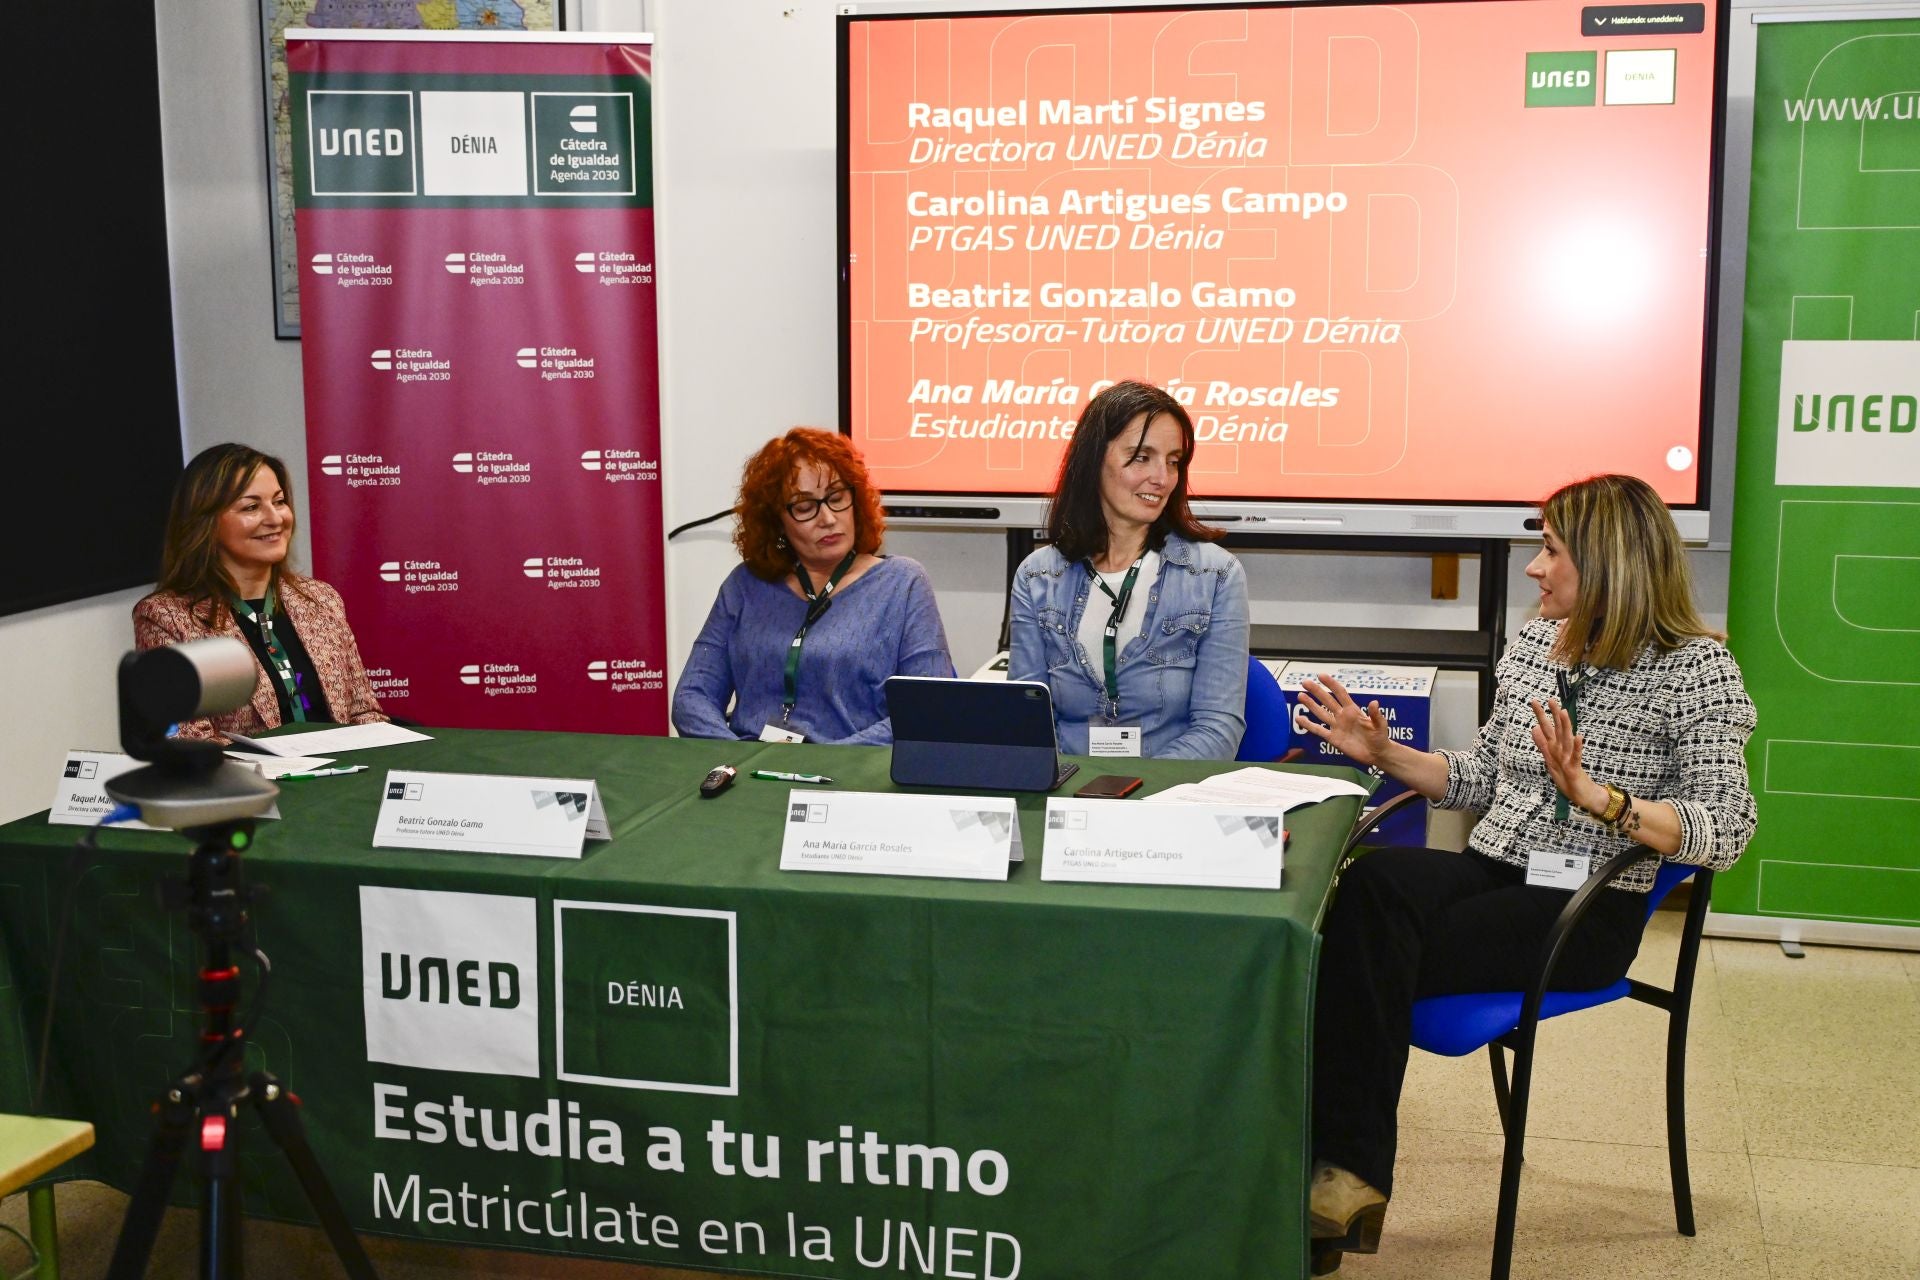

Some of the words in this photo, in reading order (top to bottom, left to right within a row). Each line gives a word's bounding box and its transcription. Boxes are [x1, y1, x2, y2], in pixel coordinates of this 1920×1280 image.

[1532, 71, 1590, 88] UNED
[908, 100, 1026, 132] Raquel
[1039, 97, 1138, 126] Martí
[1145, 97, 1266, 130] Signes
[320, 128, 403, 156] UNED
[451, 135, 497, 154] DÉNIA
[560, 138, 606, 151] Cátedra
[909, 138, 1055, 164] Directora
[1066, 134, 1161, 160] UNED
[1171, 132, 1267, 159] Dénia
[550, 154, 564, 165] de
[568, 154, 619, 168] Igualdad
[551, 170, 589, 182] Agenda
[592, 170, 619, 180] 2030
[908, 190, 1050, 217] Carolina
[1060, 189, 1211, 221] Artigues
[1222, 187, 1348, 219] Campo
[909, 224, 1015, 251] PTGAS
[1026, 224, 1120, 250] UNED
[1129, 222, 1224, 250] Dénia
[337, 253, 373, 262] Cátedra
[470, 253, 506, 261] Cátedra
[599, 252, 634, 261] Cátedra
[337, 265, 349, 274] de
[351, 265, 391, 276] Igualdad
[470, 265, 482, 273] de
[484, 264, 523, 275] Igualdad
[600, 264, 611, 272] de
[612, 263, 651, 275] Igualdad
[338, 277, 368, 287] Agenda
[371, 277, 392, 285] 2030
[471, 277, 500, 286] Agenda
[502, 276, 524, 284] 2030
[600, 276, 629, 286] Agenda
[909, 283, 1030, 308] Beatriz
[1039, 282, 1182, 308] Gonzalo
[1192, 282, 1296, 308] Gamo
[909, 316, 1185, 349] Profesora-Tutora
[1196, 318, 1293, 344] UNED
[1303, 316, 1401, 344] Dénia
[396, 349, 432, 358] Cátedra
[541, 347, 576, 356] Cátedra
[396, 361, 408, 369] de
[410, 360, 450, 372] Igualdad
[541, 359, 553, 367] de
[555, 359, 593, 370] Igualdad
[397, 373, 427, 383] Agenda
[429, 372, 450, 380] 2030
[542, 371, 571, 381] Agenda
[573, 370, 594, 378] 2030
[908, 379, 972, 404] Ana
[981, 379, 1079, 405] María
[1205, 380, 1339, 408] Rosales
[1793, 394, 1918, 433] UNED
[910, 413, 1077, 440] Estudiante
[1196, 413, 1288, 442] Dénia
[346, 454, 382, 463] Cátedra
[477, 452, 512, 461] Cátedra
[605, 450, 640, 458] Cátedra
[347, 466, 358, 474] de
[361, 465, 400, 476] Igualdad
[477, 464, 488, 472] de
[491, 463, 530, 474] Igualdad
[605, 461, 616, 470] de
[618, 461, 656, 472] Igualdad
[478, 475, 507, 485] Agenda
[510, 475, 530, 483] 2030
[606, 473, 635, 482] Agenda
[637, 472, 657, 480] 2030
[348, 478, 377, 488] Agenda
[404, 561, 440, 569] Cátedra
[547, 557, 582, 566] Cátedra
[405, 572, 416, 581] de
[419, 571, 457, 582] Igualdad
[548, 569, 559, 577] de
[561, 568, 599, 579] Igualdad
[405, 584, 435, 593] Agenda
[438, 583, 458, 591] 2030
[548, 580, 577, 589] Agenda
[580, 579, 600, 587] 2030
[484, 664, 519, 672] Cátedra
[611, 660, 645, 669] Cátedra
[366, 668, 392, 676] tedra
[611, 671, 623, 680] de
[625, 670, 662, 681] Igualdad
[484, 675, 495, 684] de
[498, 674, 536, 685] Igualdad
[485, 687, 514, 696] Agenda
[612, 682, 641, 692] Agenda
[388, 690, 409, 698] 2030
[71, 794, 96, 804] Raquel
[399, 816, 425, 825] Beatriz
[428, 817, 458, 827] Gonzalo
[461, 819, 483, 828] Gamo
[803, 840, 819, 848] Ana
[823, 841, 846, 850] María
[850, 842, 877, 851] García
[880, 843, 912, 852] Rosales
[1064, 847, 1101, 857] Carolina
[1105, 848, 1143, 860] Artigues
[1147, 849, 1183, 861] Campos
[381, 952, 521, 1010] UNED
[607, 979, 684, 1010] DÉNIA
[373, 1081, 625, 1167] Estudia
[647, 1124, 684, 1174] a
[707, 1119, 781, 1179] tu
[807, 1124, 1009, 1197] ritmo
[373, 1171, 681, 1250] Matricúlate
[699, 1217, 766, 1257] en
[787, 1211, 834, 1263] la
[854, 1215, 1022, 1280] UNED
